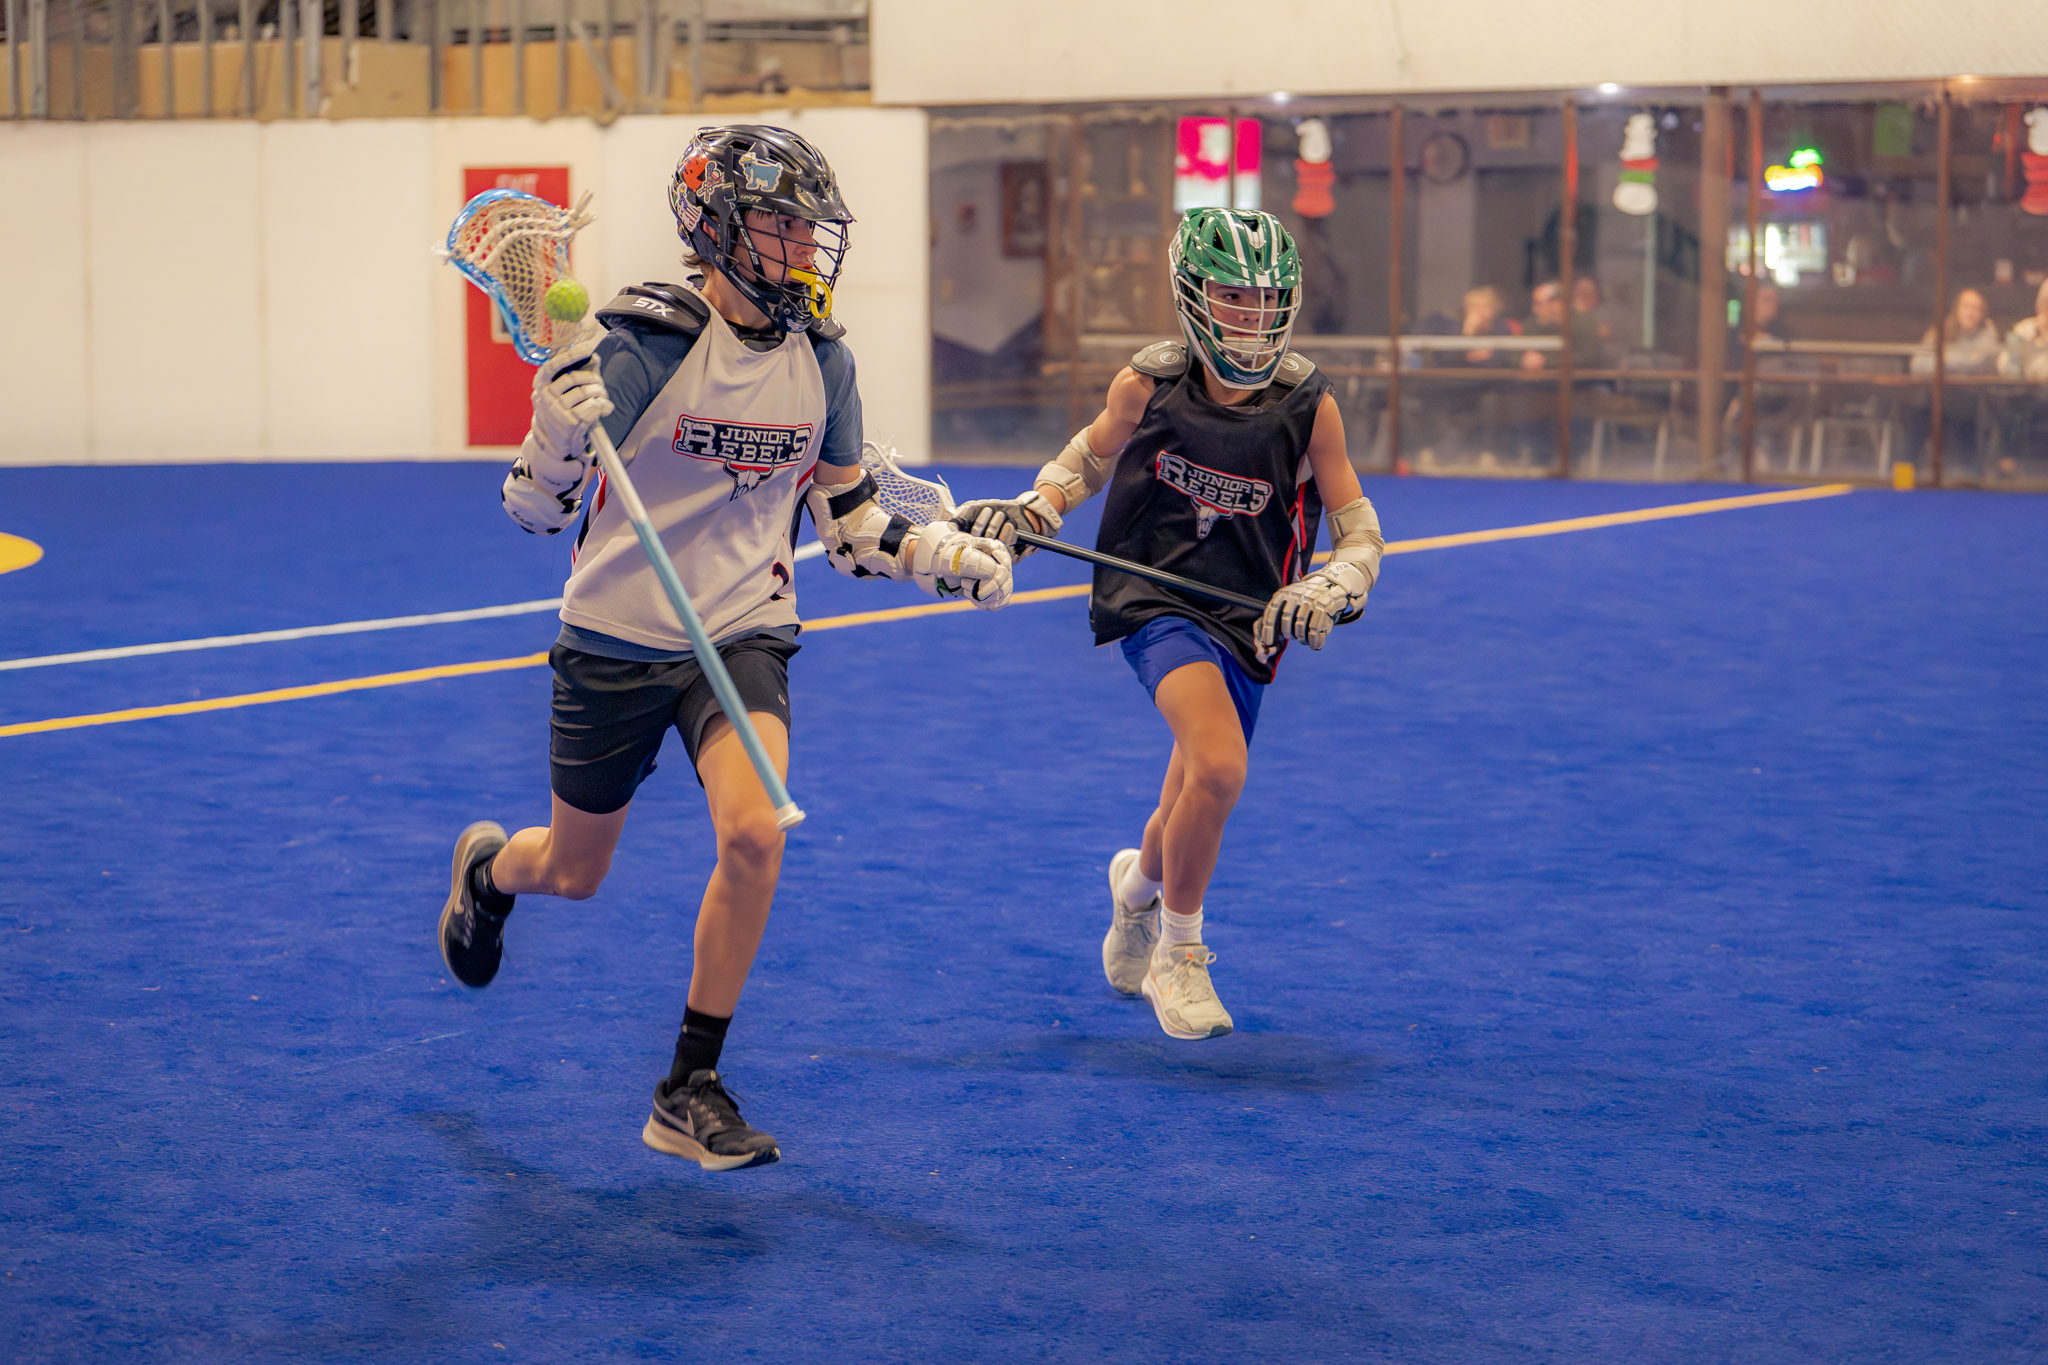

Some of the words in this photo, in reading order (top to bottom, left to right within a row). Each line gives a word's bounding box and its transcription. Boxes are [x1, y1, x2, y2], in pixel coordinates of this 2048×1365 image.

[632, 297, 675, 318] STX
[676, 419, 811, 463] REBELS
[720, 427, 791, 444] JUNIOR
[1159, 454, 1269, 512] REBELS
[1188, 469, 1252, 494] JUNIOR
